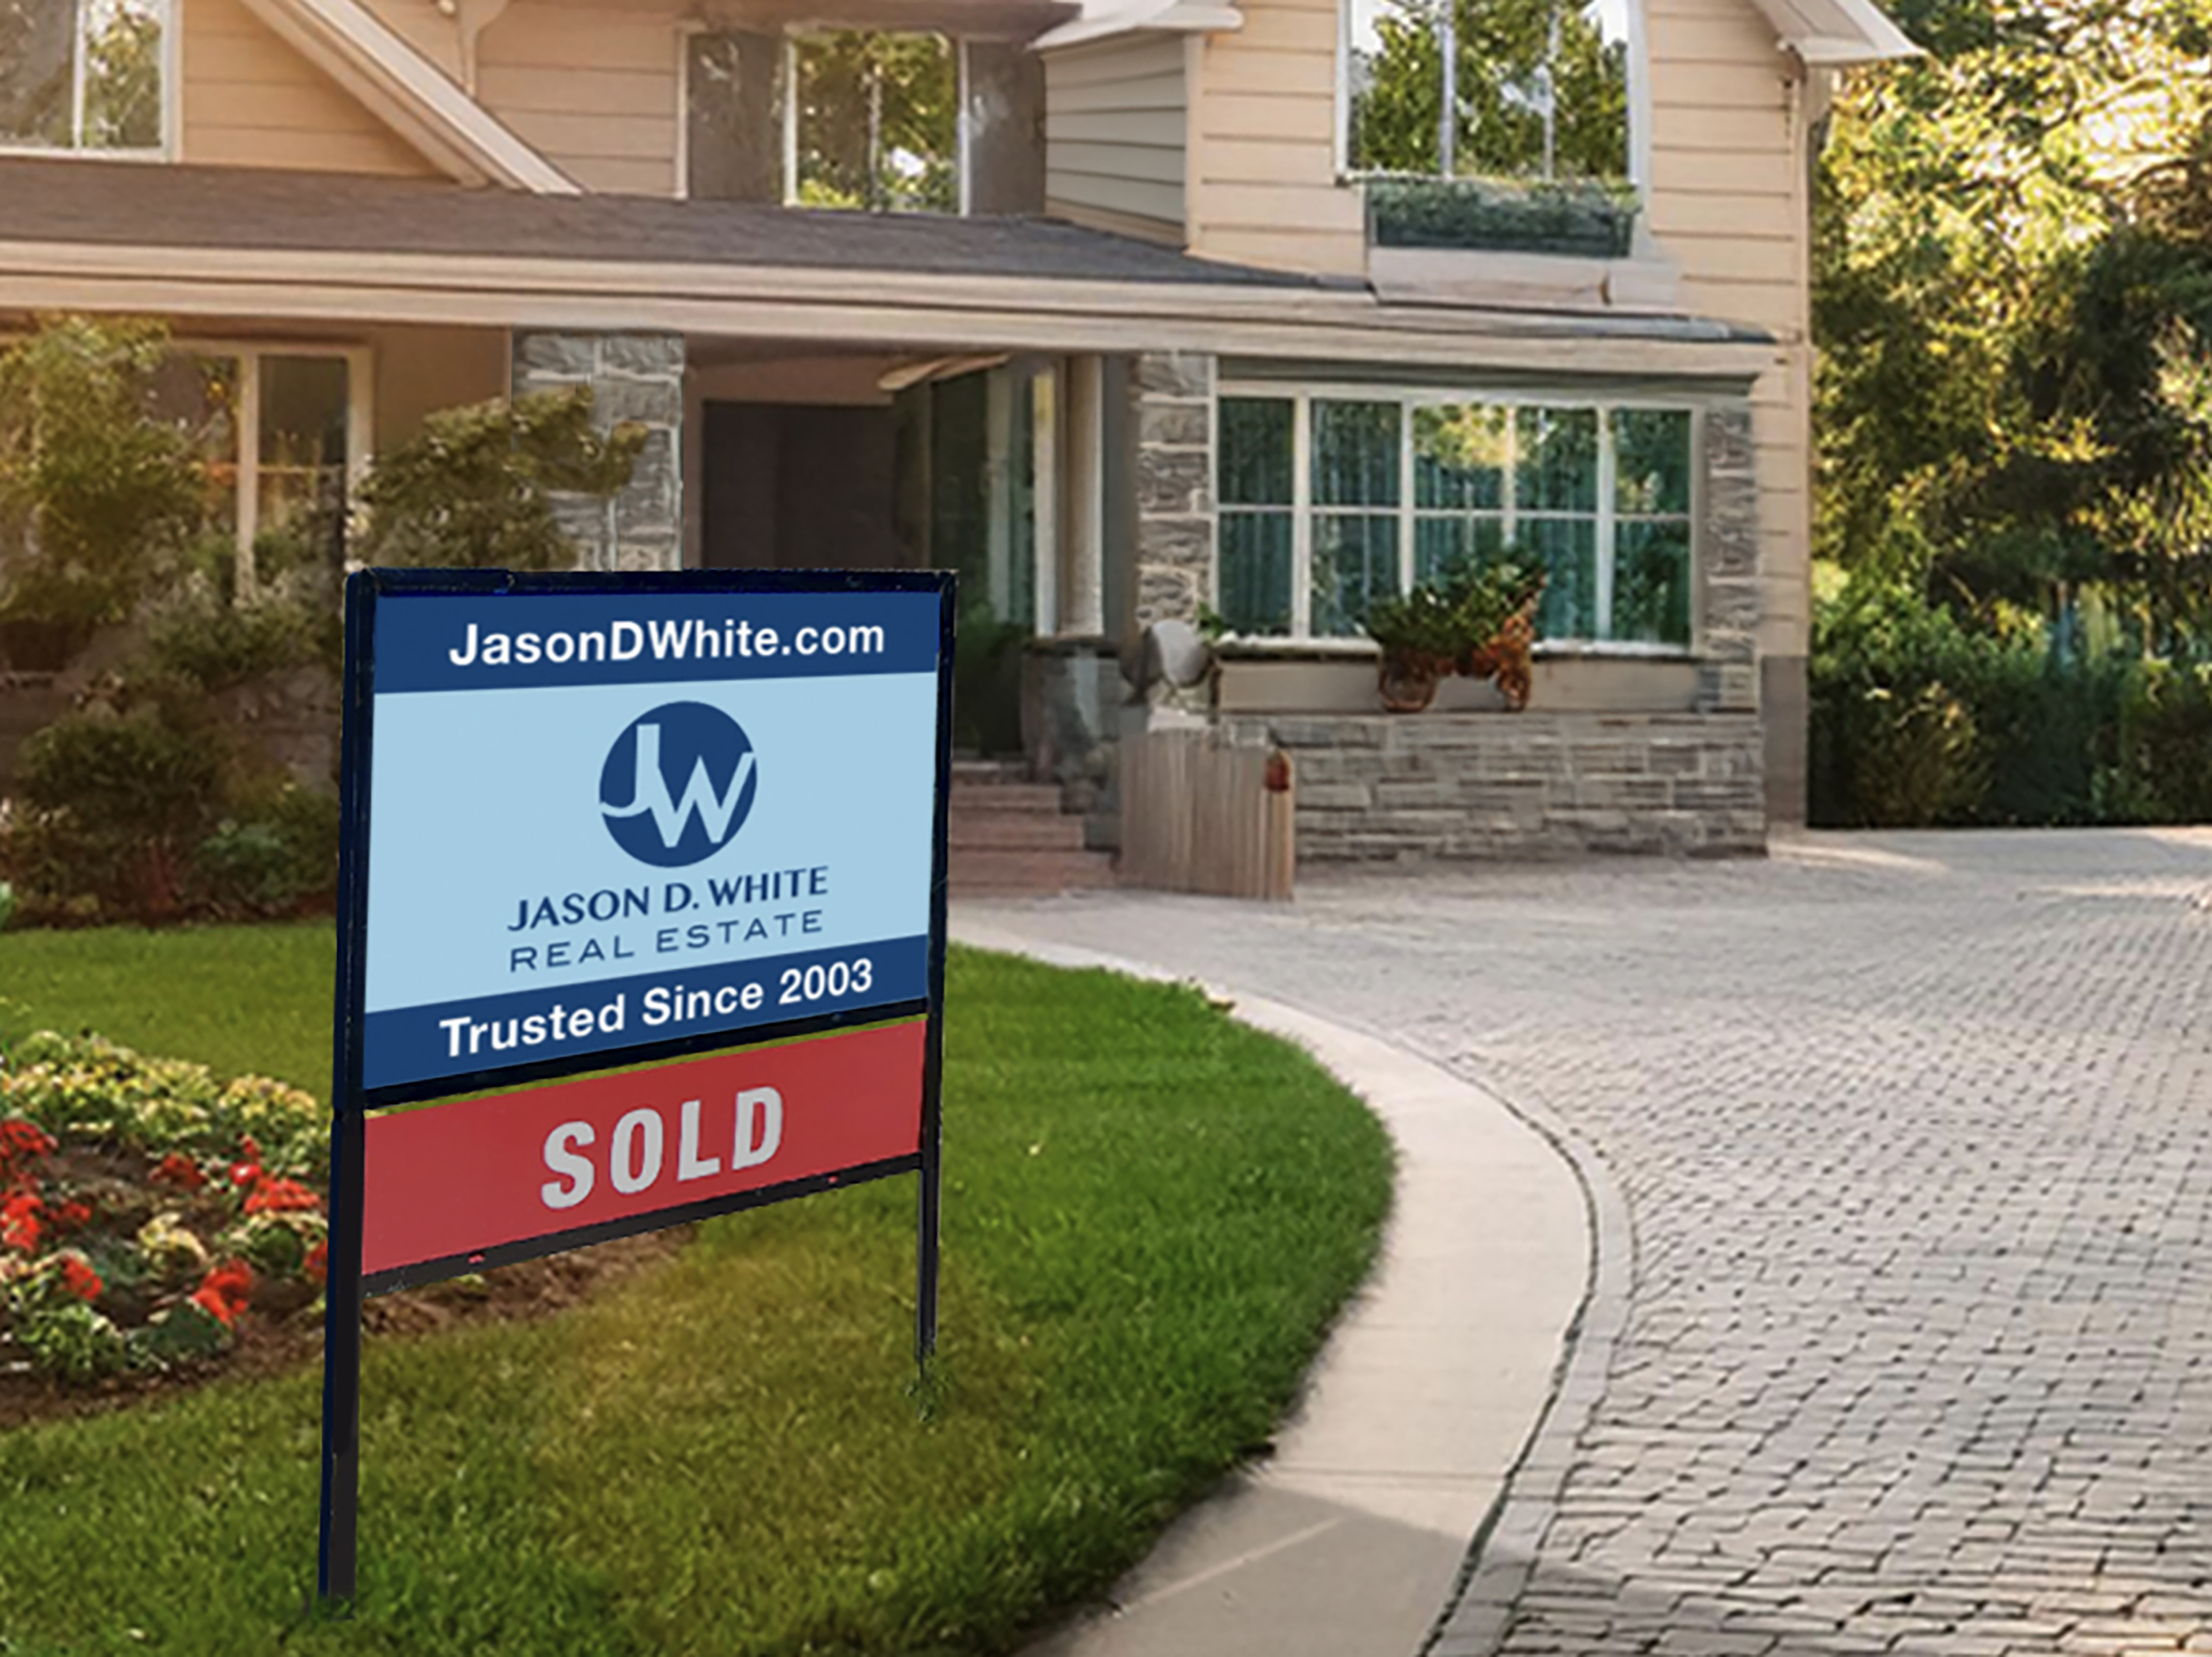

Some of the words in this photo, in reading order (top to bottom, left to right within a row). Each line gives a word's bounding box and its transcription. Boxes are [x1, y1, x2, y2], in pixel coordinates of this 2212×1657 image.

[449, 619, 884, 666] JasonDWhite.com
[599, 723, 754, 848] JW
[507, 886, 650, 932] JASON
[664, 882, 701, 913] D.
[707, 866, 828, 907] WHITE
[510, 935, 634, 973] REAL
[656, 909, 822, 953] ESTATE
[439, 994, 625, 1057] Trusted
[642, 983, 764, 1025] Since
[779, 958, 872, 1004] 2003
[541, 1086, 783, 1209] SOLD
